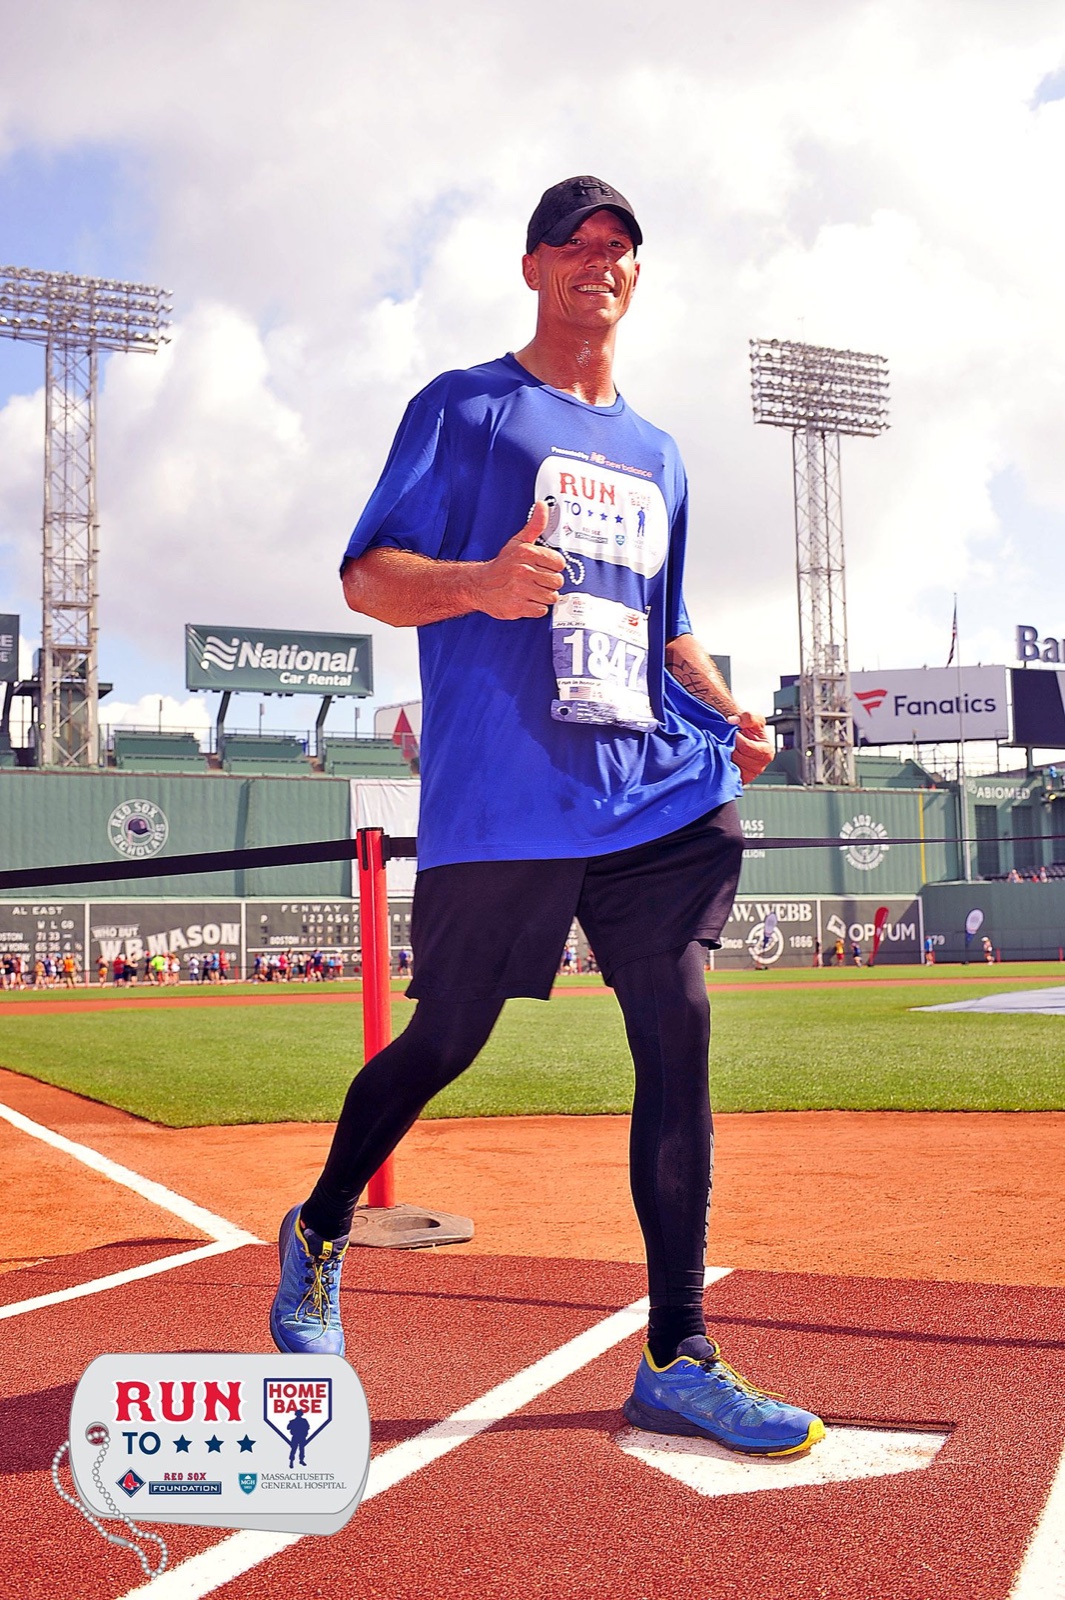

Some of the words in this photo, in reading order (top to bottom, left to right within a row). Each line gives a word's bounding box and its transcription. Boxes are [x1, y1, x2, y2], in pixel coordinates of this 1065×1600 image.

[559, 472, 615, 506] RUN
[564, 500, 582, 516] TO
[1016, 625, 1065, 663] Ba
[236, 641, 357, 673] National
[563, 629, 647, 690] 1847
[279, 672, 304, 684] Car
[308, 673, 352, 687] Rental
[894, 693, 997, 717] Fanatics
[976, 786, 1031, 800] ABIOMED
[111, 804, 132, 828] RED
[134, 801, 159, 818] SOX
[113, 823, 165, 856] SCHOLARS
[12, 906, 28, 915] AL
[32, 906, 64, 915] EAST
[281, 904, 341, 914] FENWAY
[754, 903, 812, 922] WEBB
[50, 920, 58, 930] L
[92, 926, 117, 939] WHO
[118, 926, 139, 937] BUT
[146, 922, 242, 958] MASON
[270, 935, 300, 945] BOSTON
